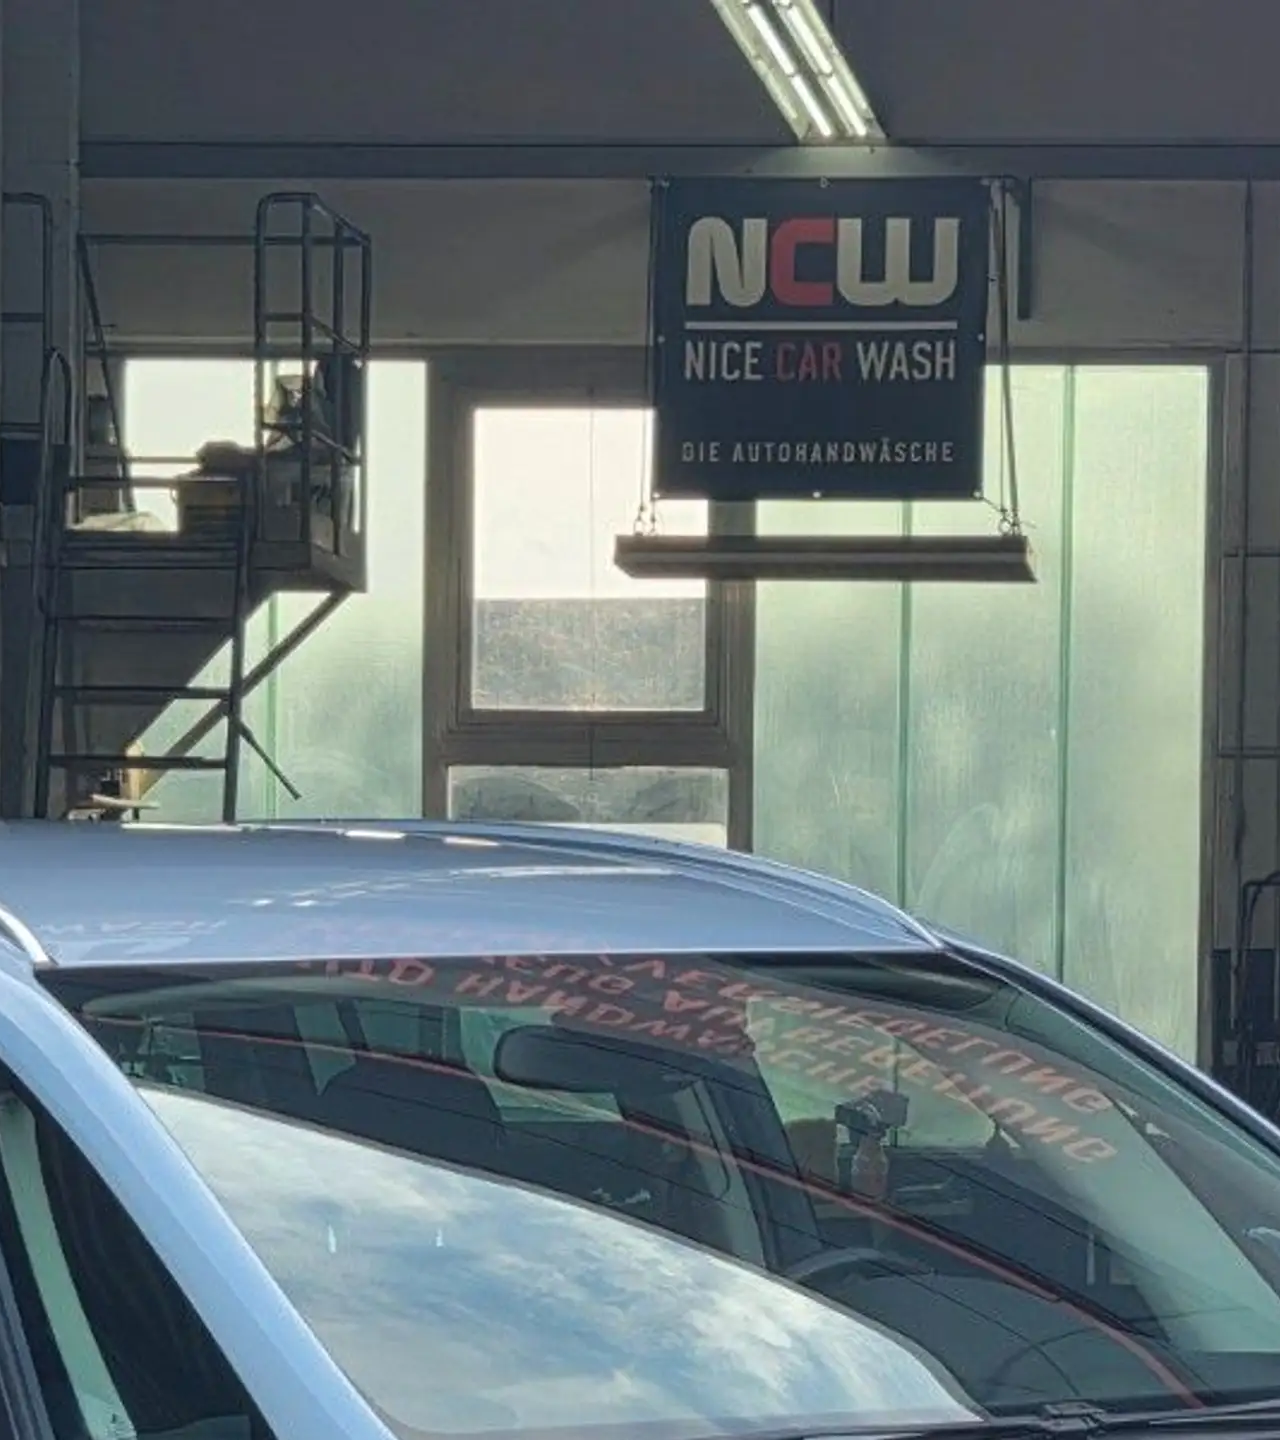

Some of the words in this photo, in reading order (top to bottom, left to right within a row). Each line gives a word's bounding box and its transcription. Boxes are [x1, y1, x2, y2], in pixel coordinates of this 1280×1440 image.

[685, 216, 960, 307] NCW
[684, 340, 763, 381] NICE
[776, 341, 843, 381] CAR
[857, 339, 956, 381] WASH
[682, 441, 719, 463] DIE
[732, 437, 954, 463] AUTOHANDWÄSCHE
